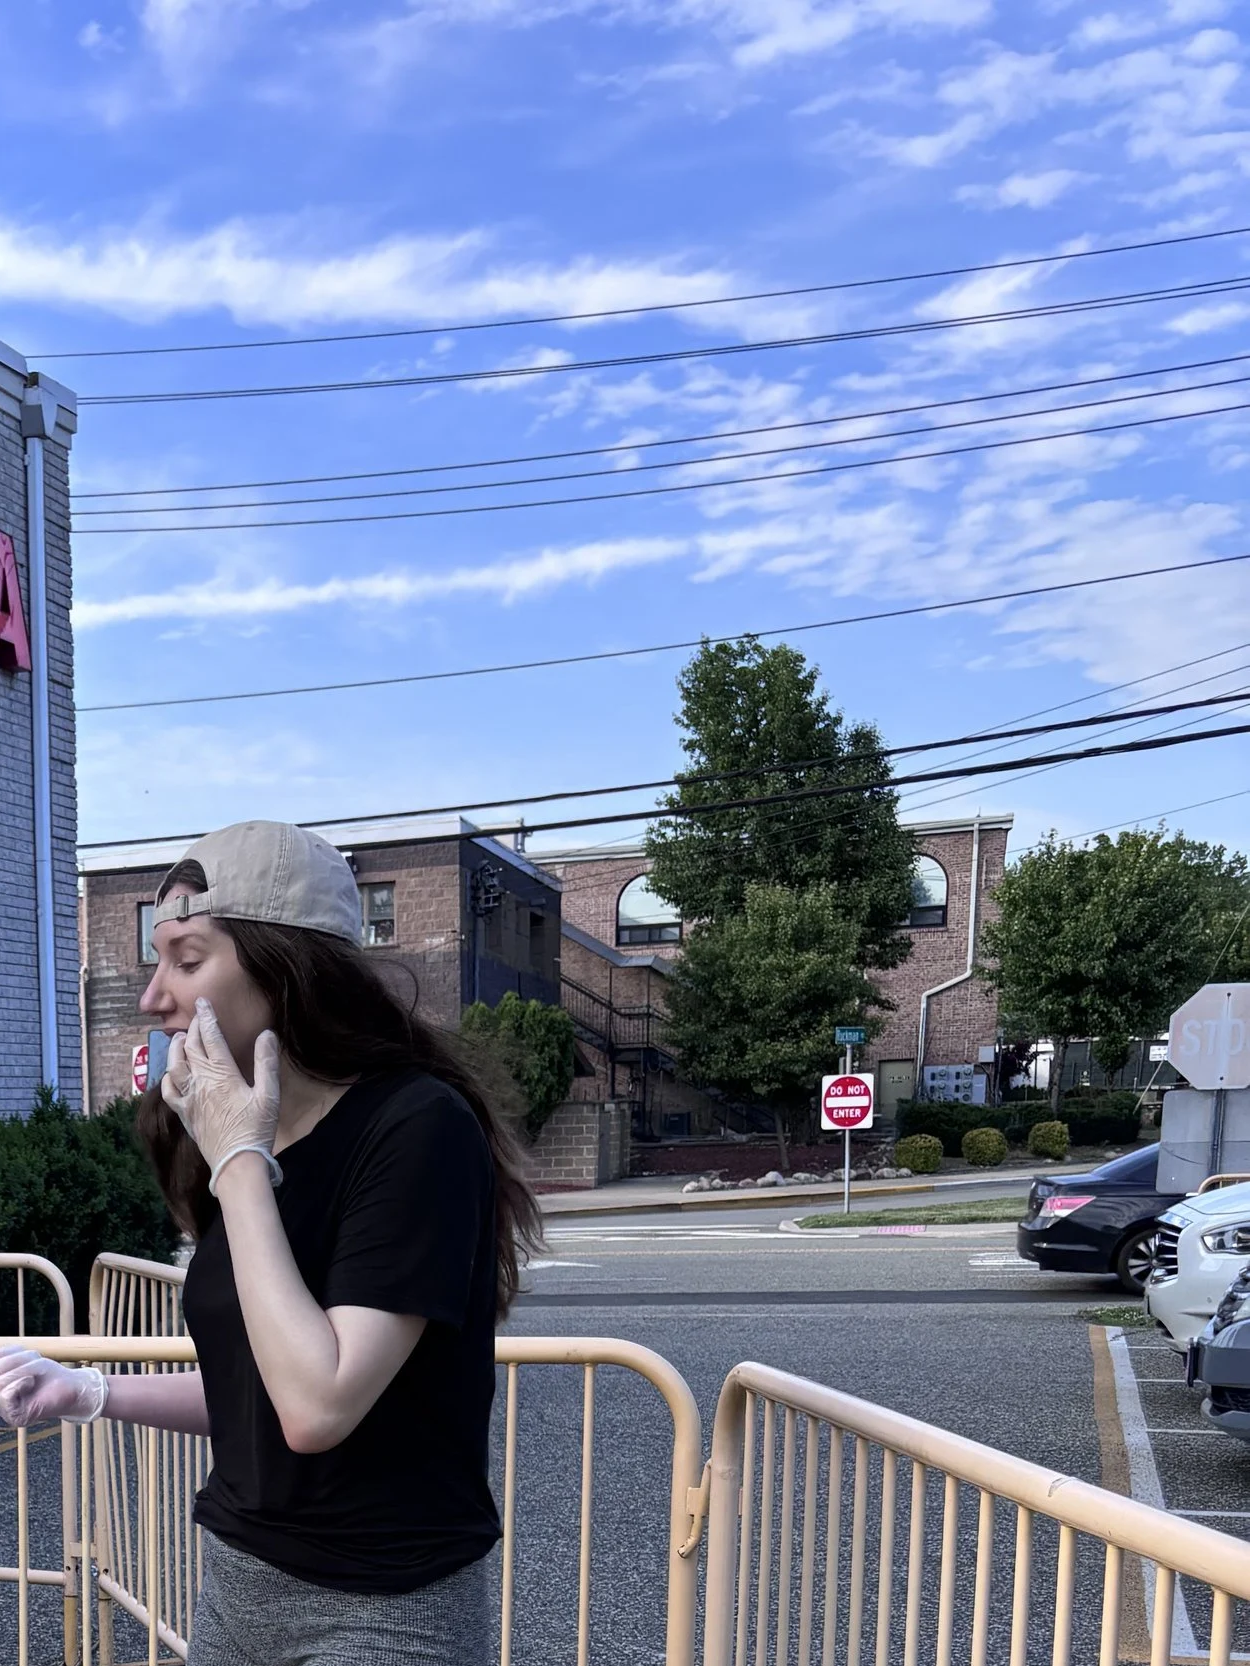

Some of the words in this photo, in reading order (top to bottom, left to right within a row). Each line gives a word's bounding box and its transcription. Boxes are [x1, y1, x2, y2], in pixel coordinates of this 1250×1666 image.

[1180, 1018, 1250, 1057] STO
[830, 1086, 843, 1096] DO
[847, 1085, 866, 1095] NOT
[832, 1108, 861, 1119] ENTER
